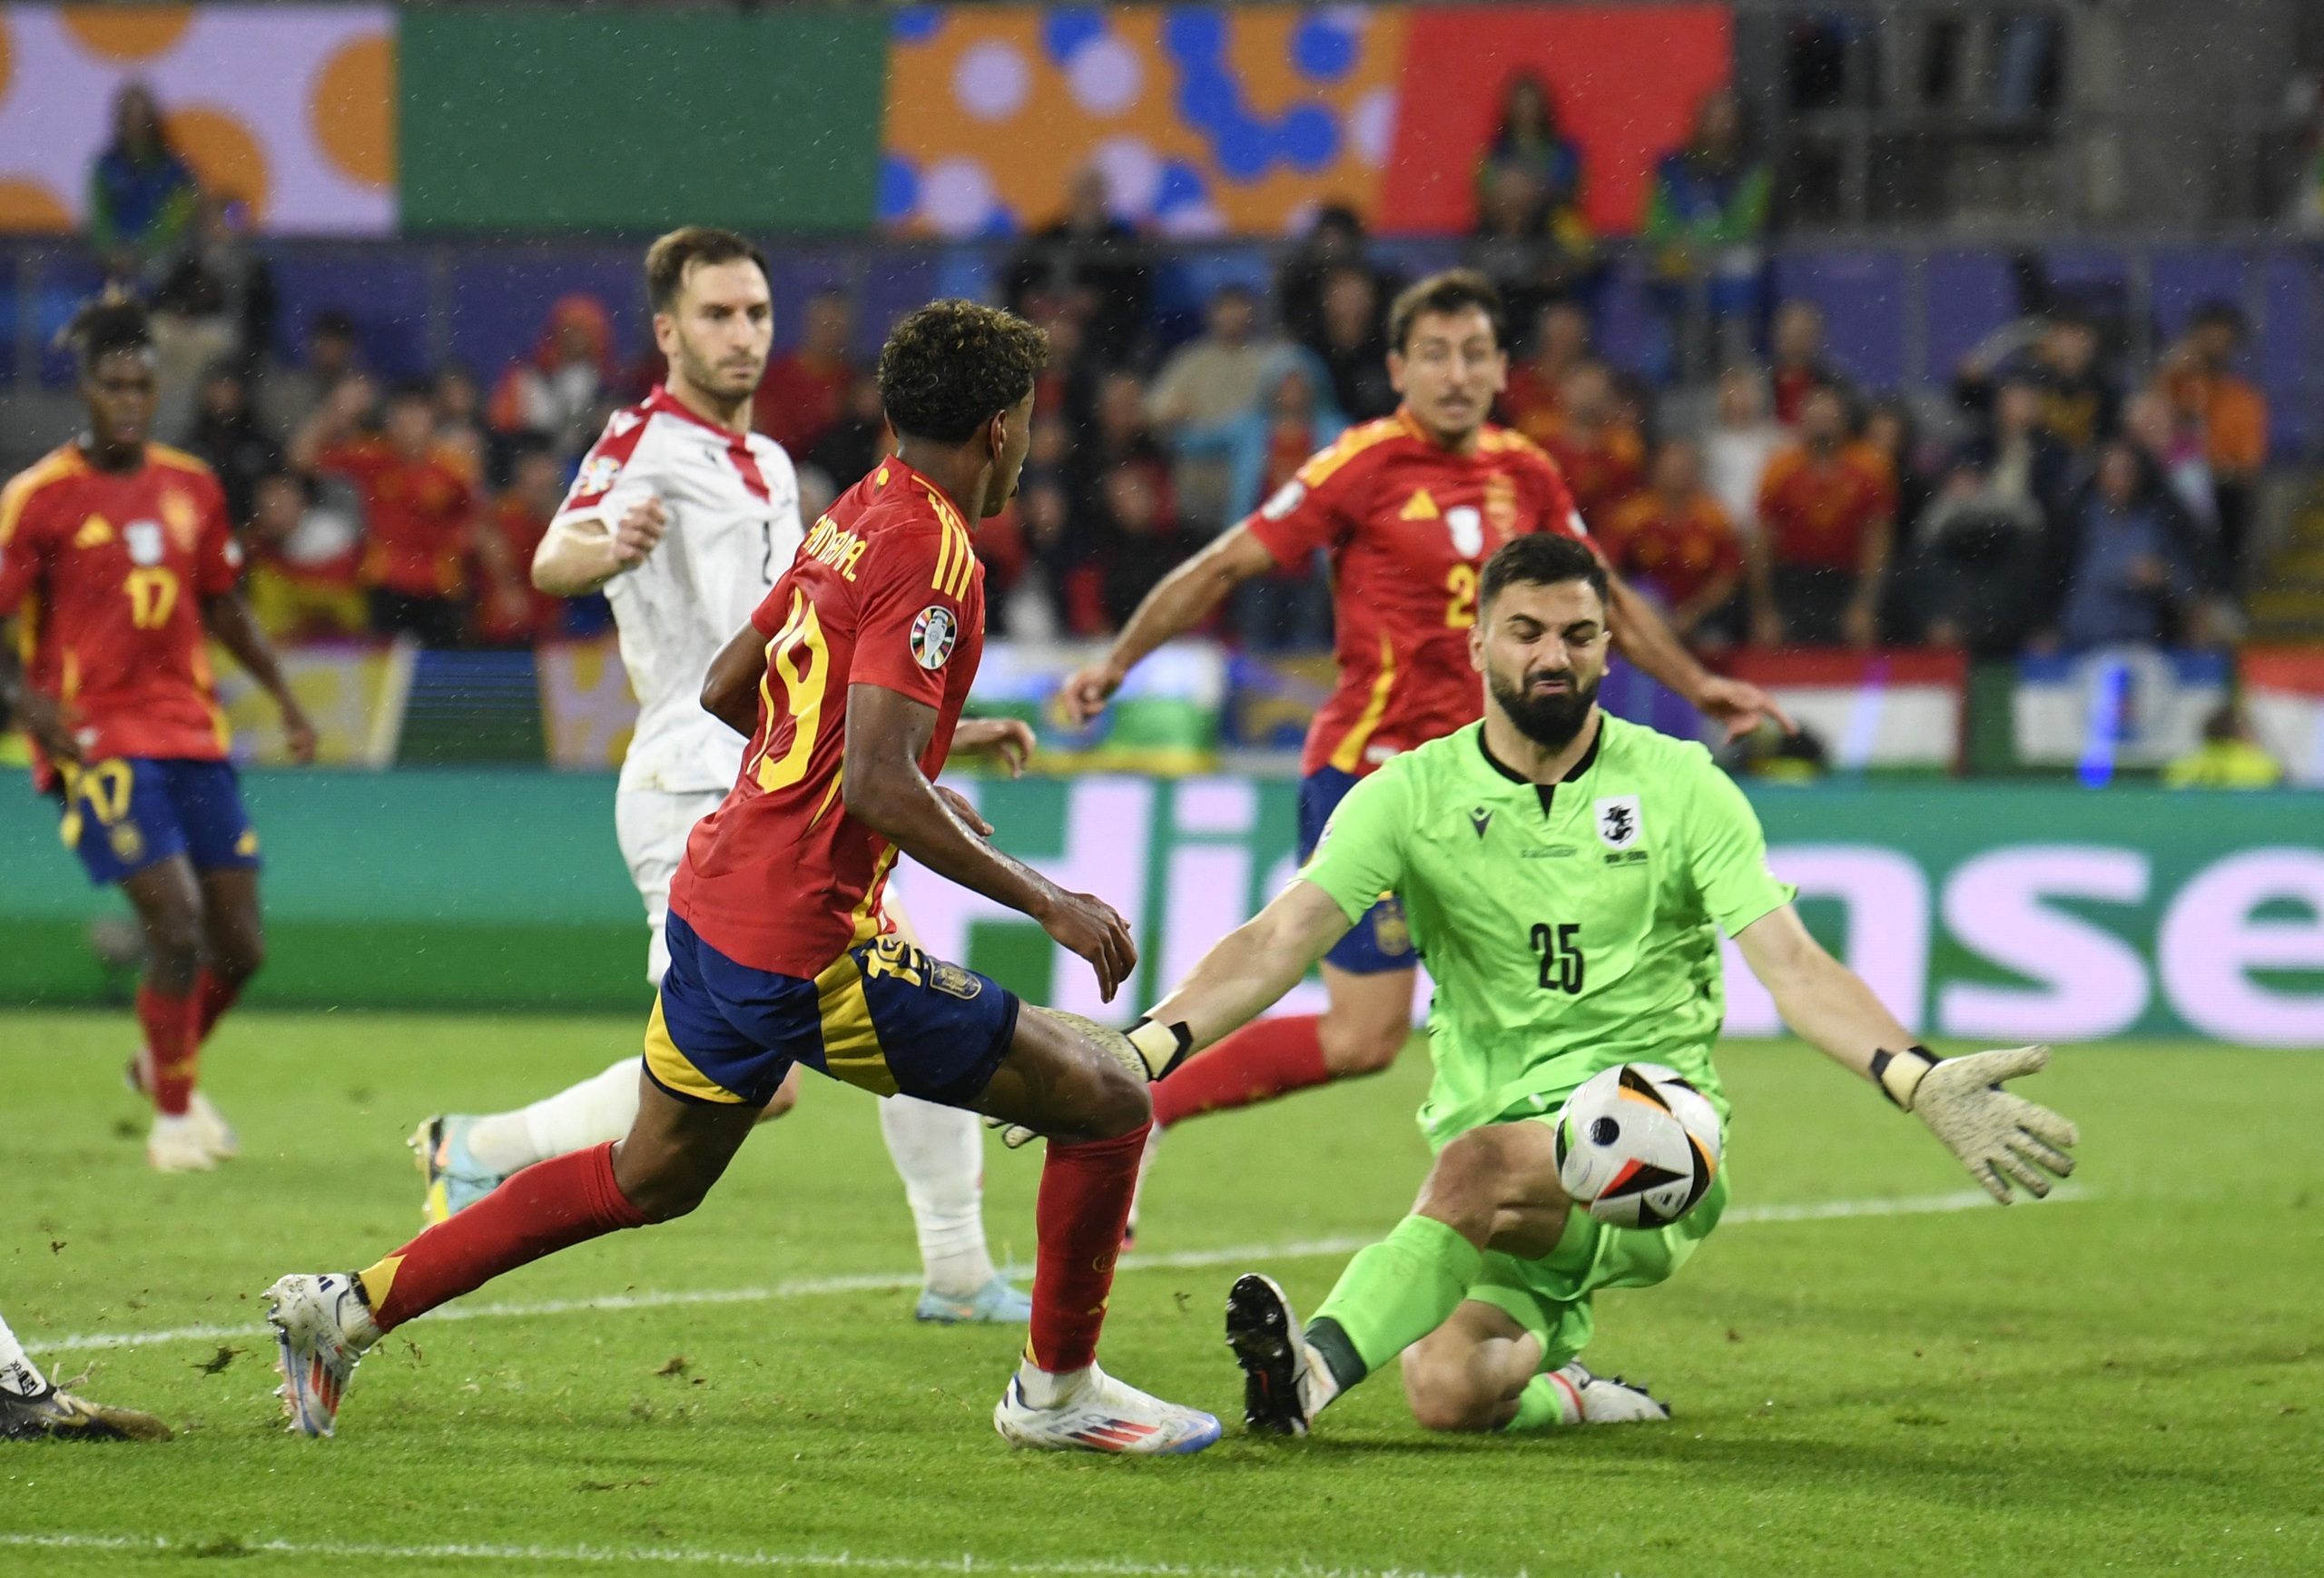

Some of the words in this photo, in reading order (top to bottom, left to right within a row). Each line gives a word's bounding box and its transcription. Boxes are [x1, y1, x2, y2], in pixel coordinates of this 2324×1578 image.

[123, 565, 179, 629] 17
[1445, 563, 1482, 628] 2
[746, 586, 830, 794] 19
[894, 774, 2324, 1049] Hinse
[1530, 922, 1586, 994] 25
